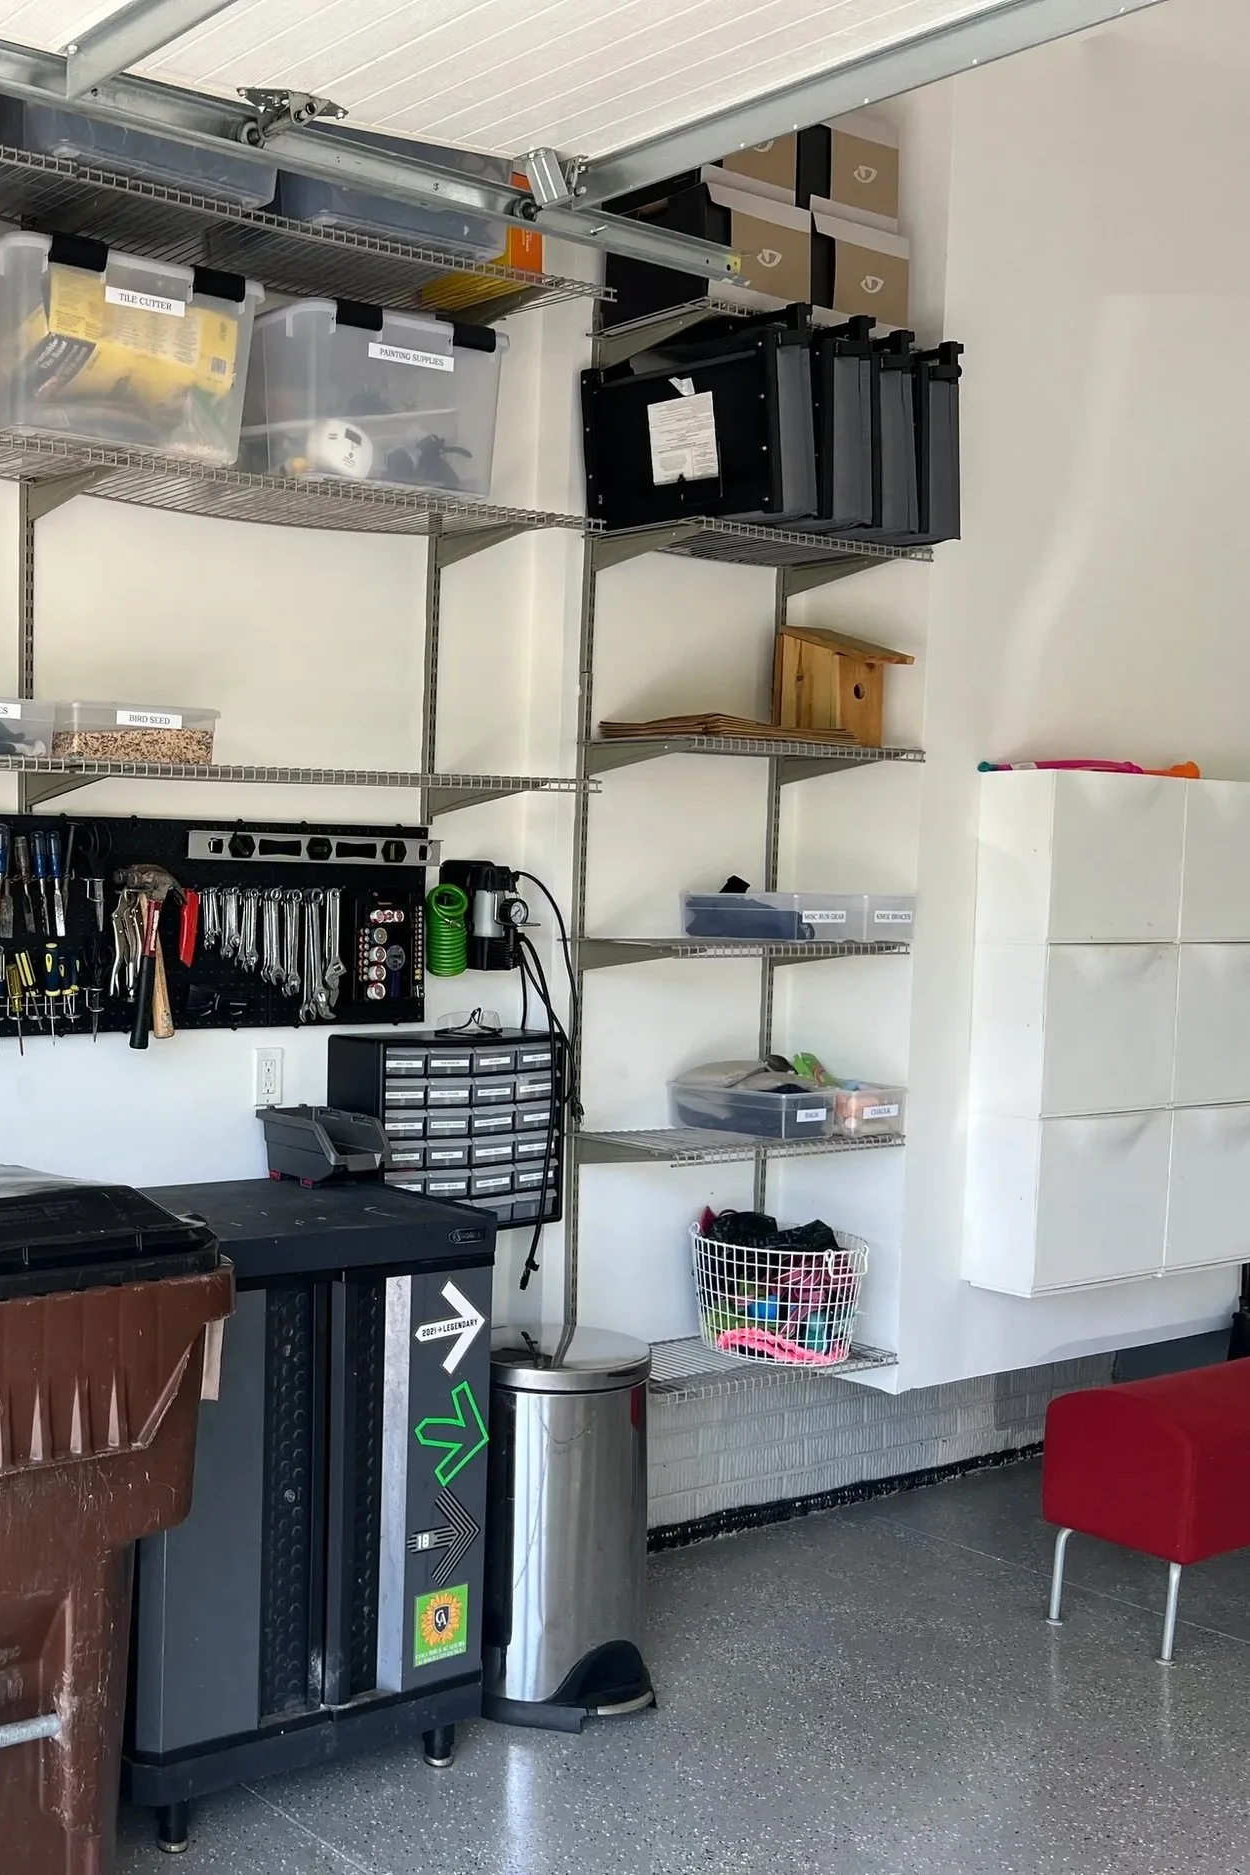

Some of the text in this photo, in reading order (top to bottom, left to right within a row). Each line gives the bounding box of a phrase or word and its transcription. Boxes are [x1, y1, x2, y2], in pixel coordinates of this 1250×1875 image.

[119, 292, 173, 311] TILE CUTTER
[379, 347, 444, 367] PAINTING SUPPLIES
[128, 713, 171, 725] BIRD SEED
[421, 1318, 478, 1337] 2021 LEGENDARY
